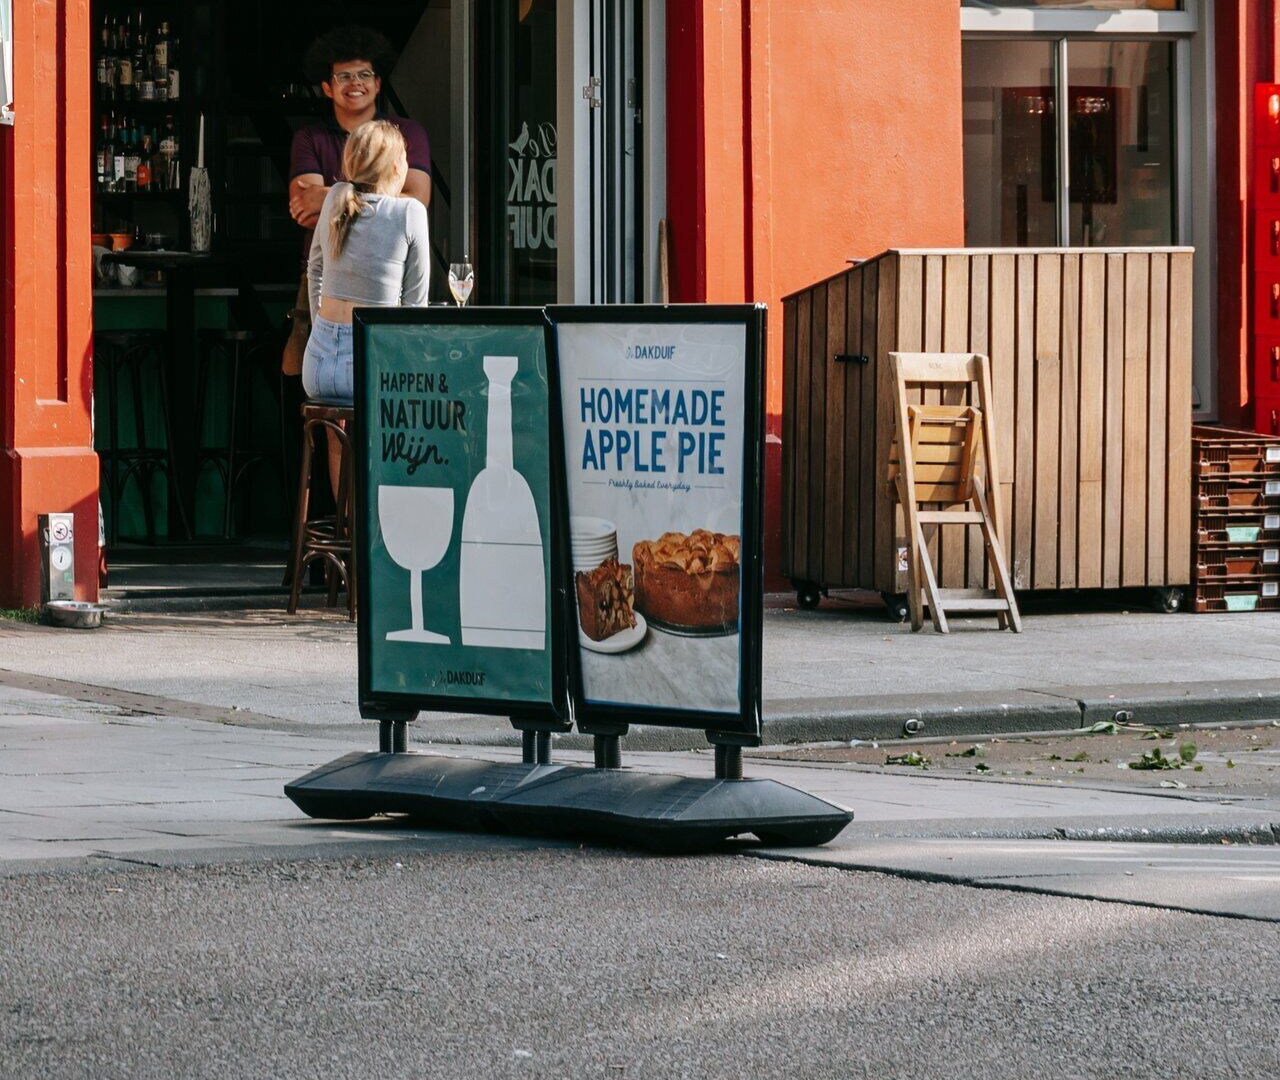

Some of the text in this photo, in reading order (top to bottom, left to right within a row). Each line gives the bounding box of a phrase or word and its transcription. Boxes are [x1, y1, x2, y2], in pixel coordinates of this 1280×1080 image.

[634, 345, 676, 360] DAKDUIF
[380, 372, 449, 394] HAPPEN &
[380, 398, 467, 431] NATUUR
[580, 387, 726, 427] HOMEMADE
[381, 431, 449, 476] Wijn.
[582, 429, 726, 475] APPLE PIE
[608, 478, 691, 493] Freshly Baked Everyday
[446, 670, 486, 686] DAKDUIF
